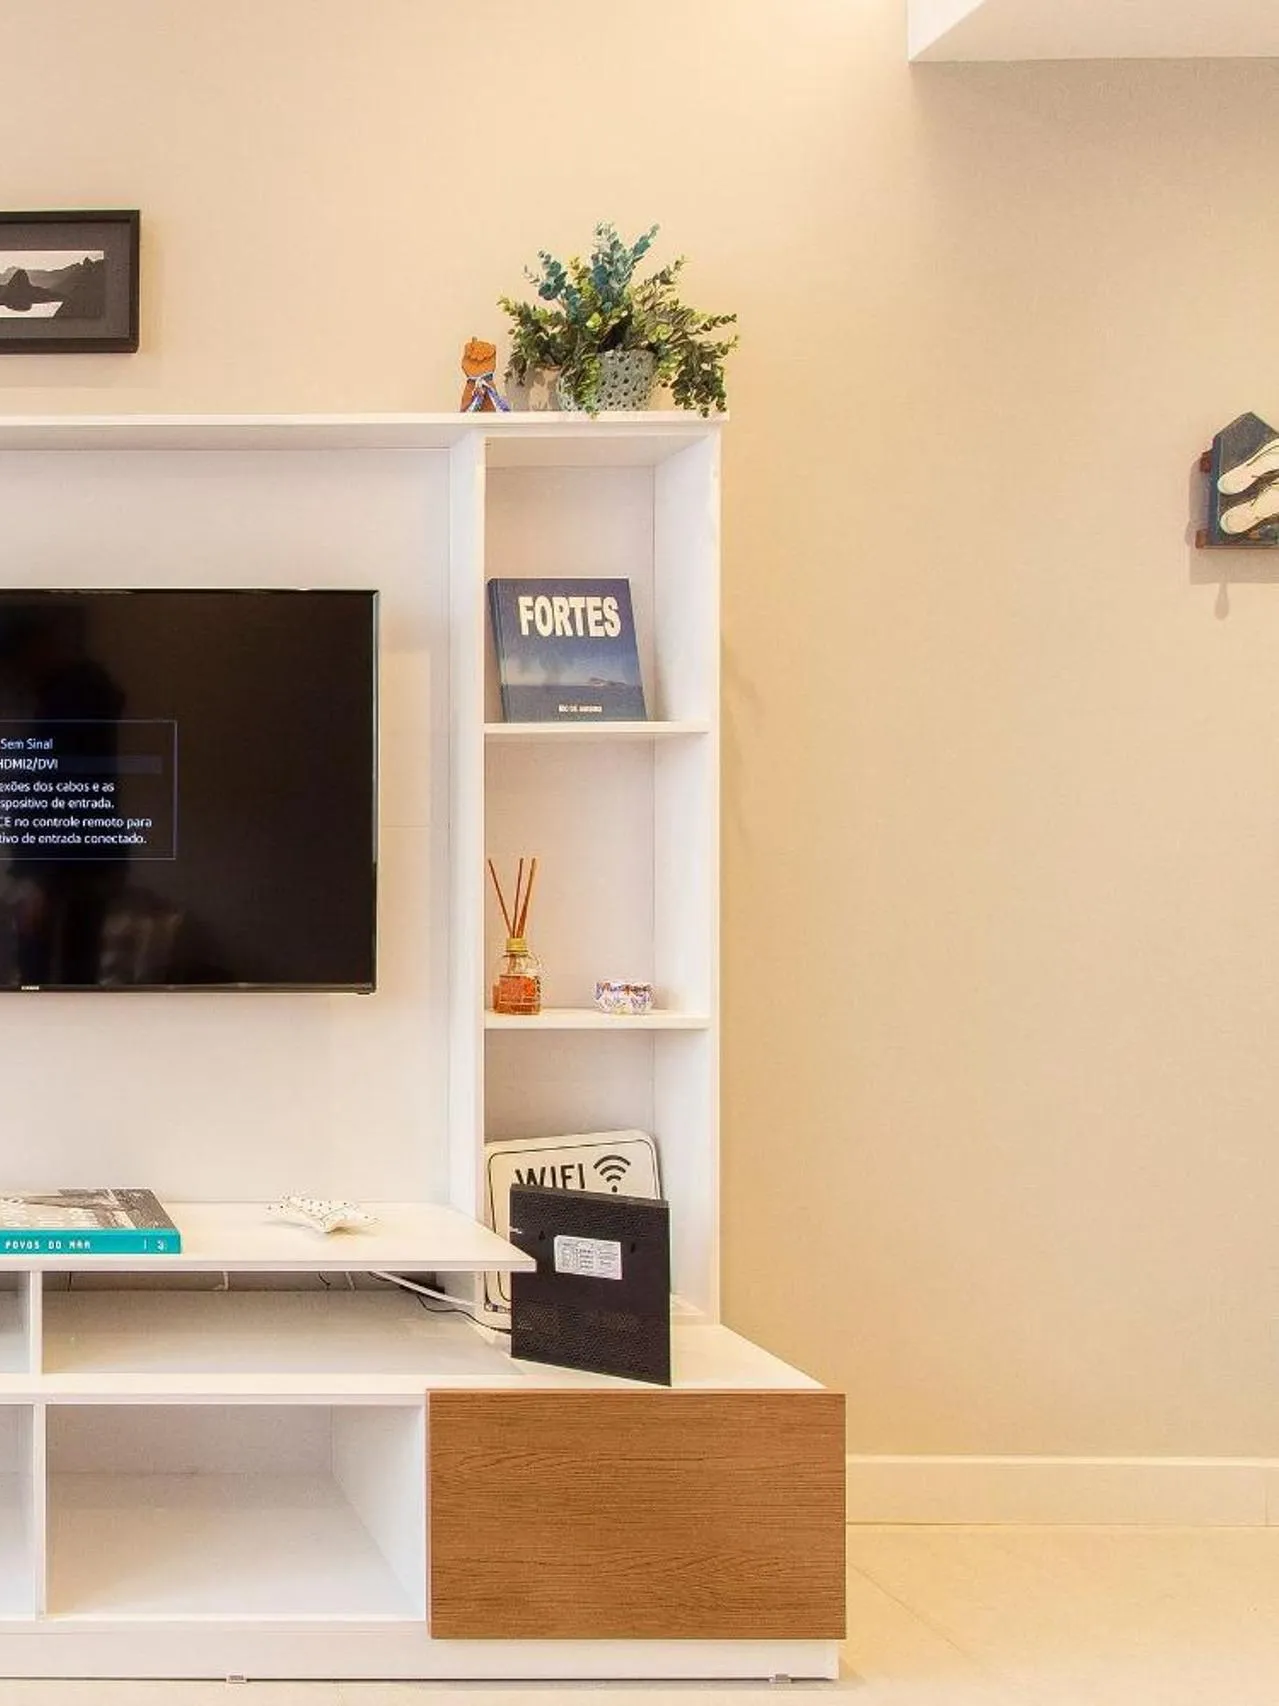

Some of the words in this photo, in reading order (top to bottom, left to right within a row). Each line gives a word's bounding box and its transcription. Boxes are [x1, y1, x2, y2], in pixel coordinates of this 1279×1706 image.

[518, 595, 621, 637] FORTES
[0, 738, 24, 750] Sem
[26, 738, 53, 750] Sinal
[33, 781, 53, 793] dos
[56, 781, 90, 793] cabos
[92, 783, 100, 793] e
[102, 783, 115, 793] as
[51, 797, 65, 808] de
[68, 797, 115, 809] entrada.
[14, 818, 29, 827] no
[32, 816, 81, 828] controle
[82, 817, 125, 828] remoto
[127, 818, 152, 829] para
[21, 832, 36, 844] de
[38, 832, 81, 844] entrada
[84, 832, 148, 844] conectado.
[514, 1163, 586, 1189] WIFI
[5, 1240, 40, 1250] POVOS
[48, 1240, 62, 1250] DO
[70, 1240, 91, 1250] MAR
